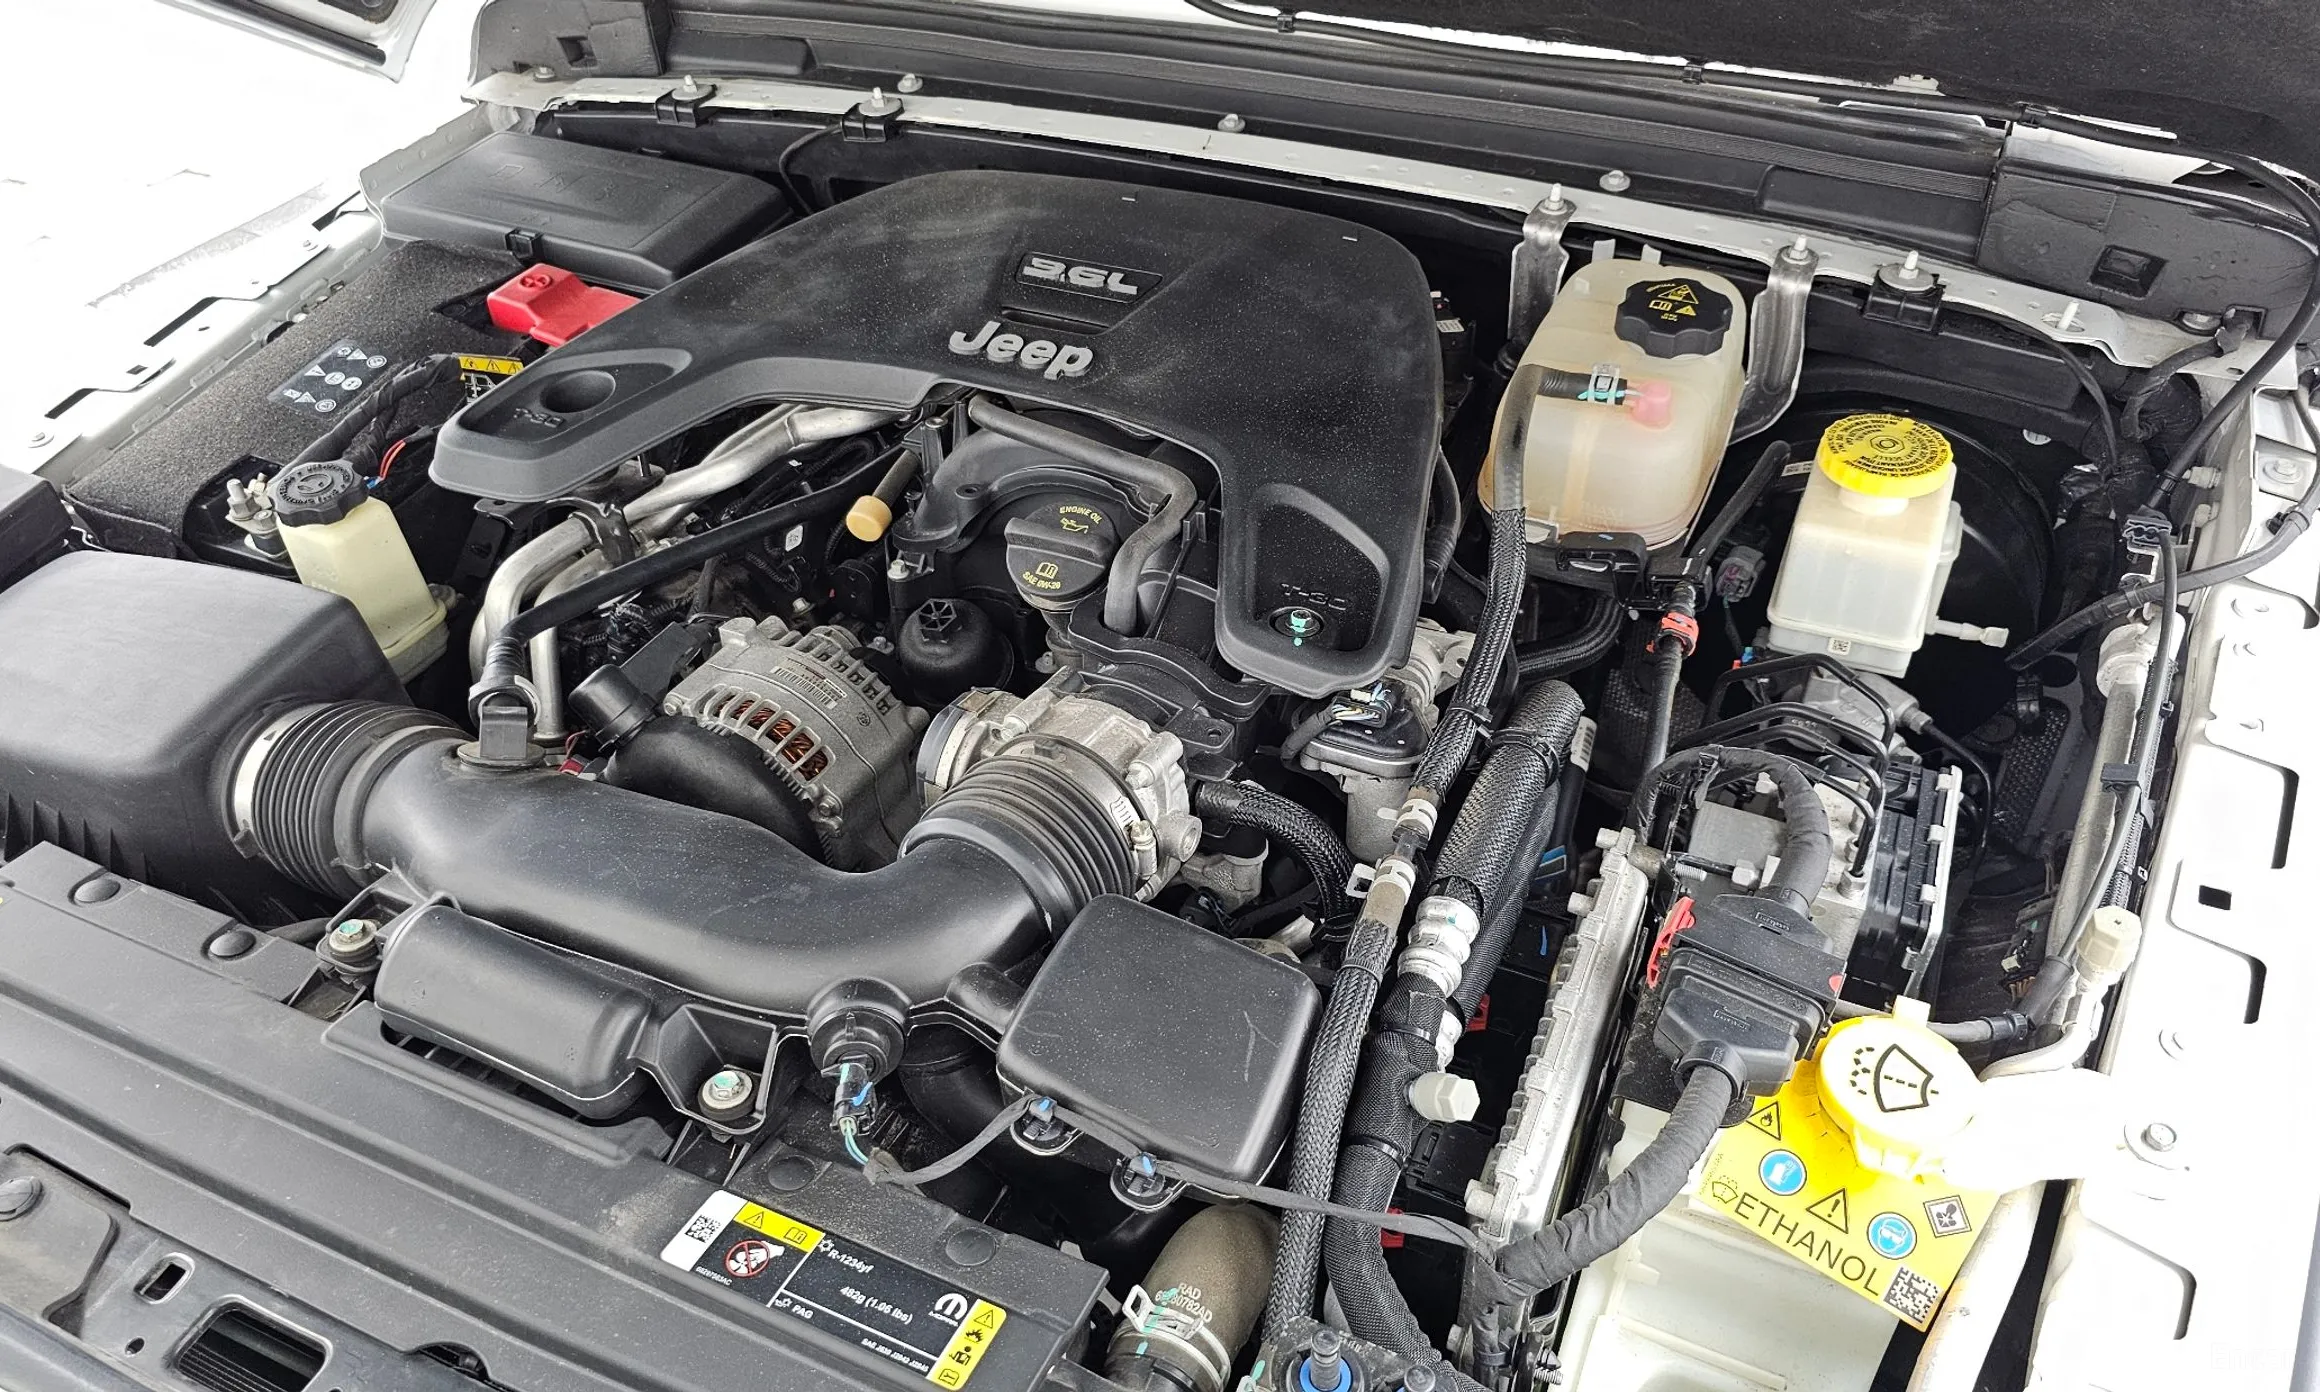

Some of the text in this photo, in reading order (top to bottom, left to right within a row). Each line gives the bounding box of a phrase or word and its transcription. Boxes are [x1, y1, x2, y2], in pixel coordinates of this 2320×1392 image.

[1022, 257, 1138, 296] 3.6L
[948, 320, 1094, 381] Jeep
[1059, 506, 1102, 524] ENGINE OIL
[1023, 571, 1038, 585] SAE
[1734, 1192, 1879, 1296] ETHANOL
[828, 1250, 874, 1274] R-1234yf
[1178, 1283, 1202, 1300] RAD
[791, 1304, 814, 1319] PAG
[840, 1286, 914, 1325] 482g (1.06 lbs)
